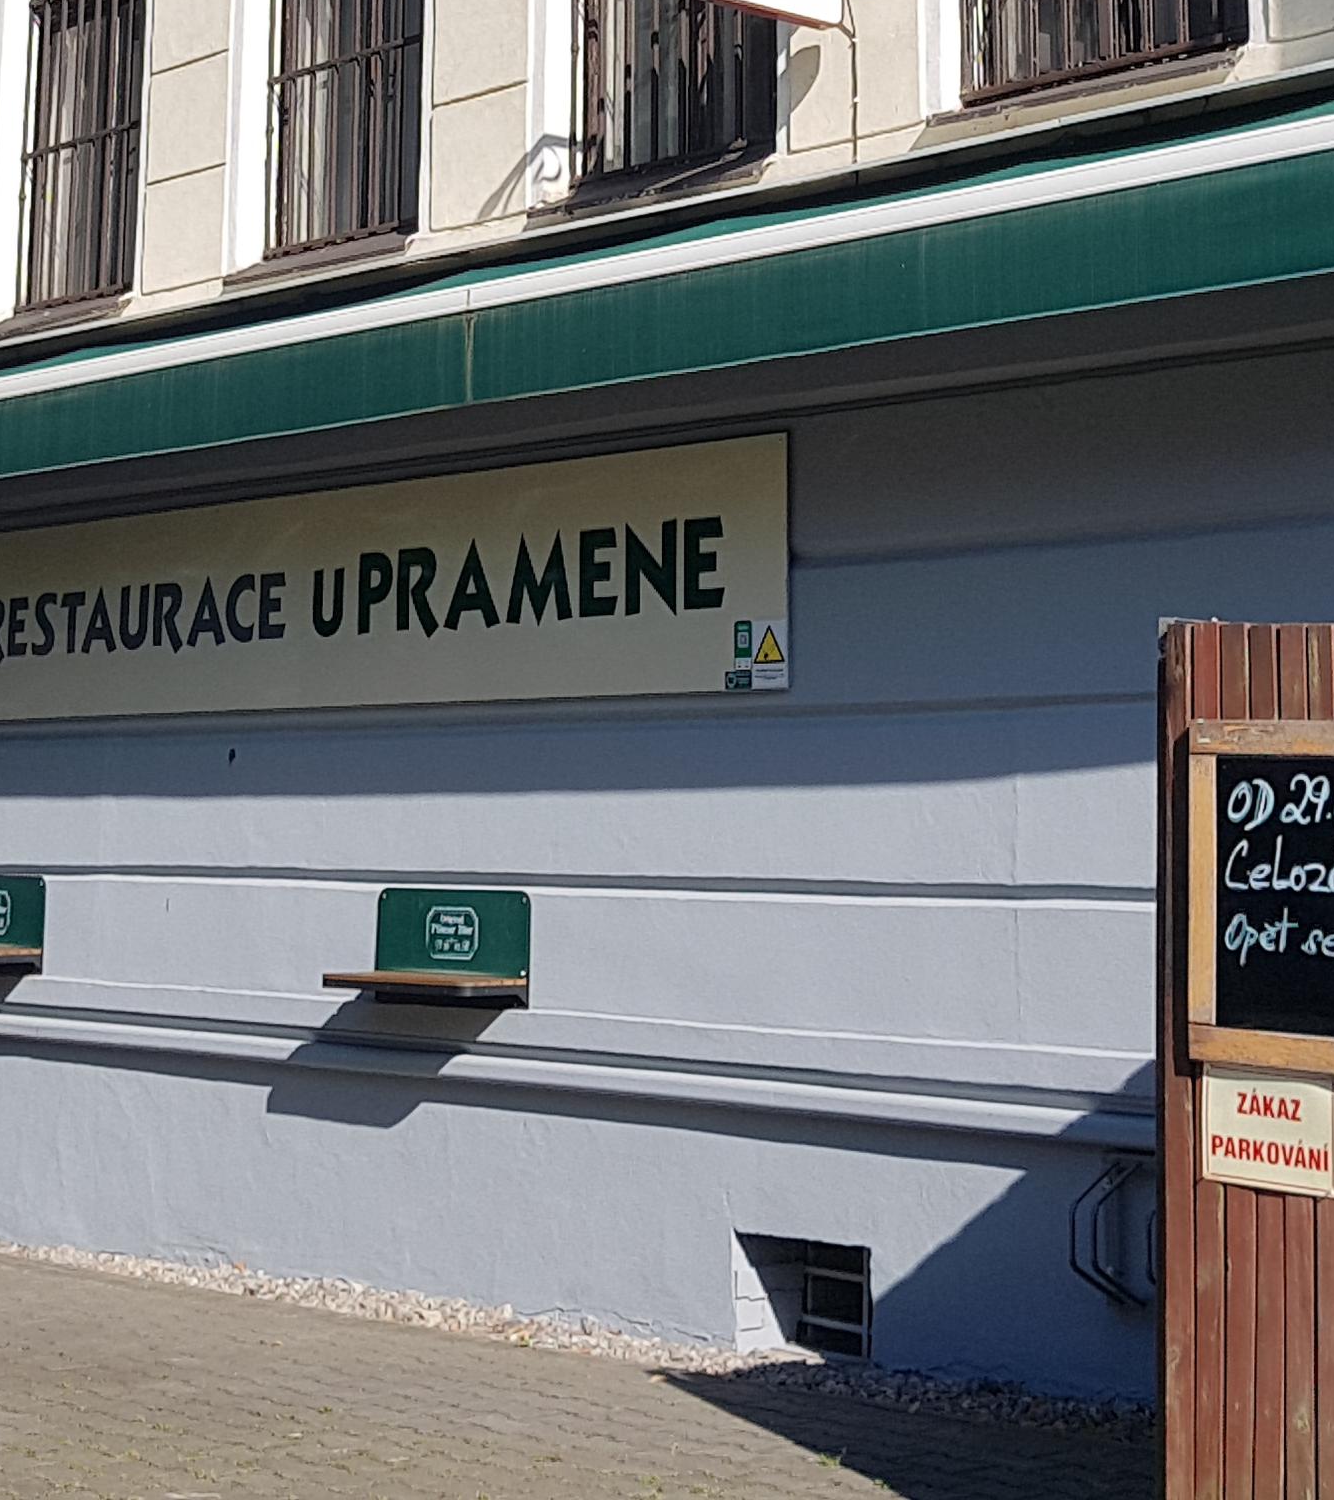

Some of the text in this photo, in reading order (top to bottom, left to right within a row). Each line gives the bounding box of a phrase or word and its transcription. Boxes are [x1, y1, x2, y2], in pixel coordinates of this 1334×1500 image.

[357, 515, 726, 639] PRAMENE
[1227, 778, 1275, 831] OD
[1236, 1087, 1302, 1122] ZÁKAZ
[1211, 1134, 1329, 1172] PARKOVÁNÍ
